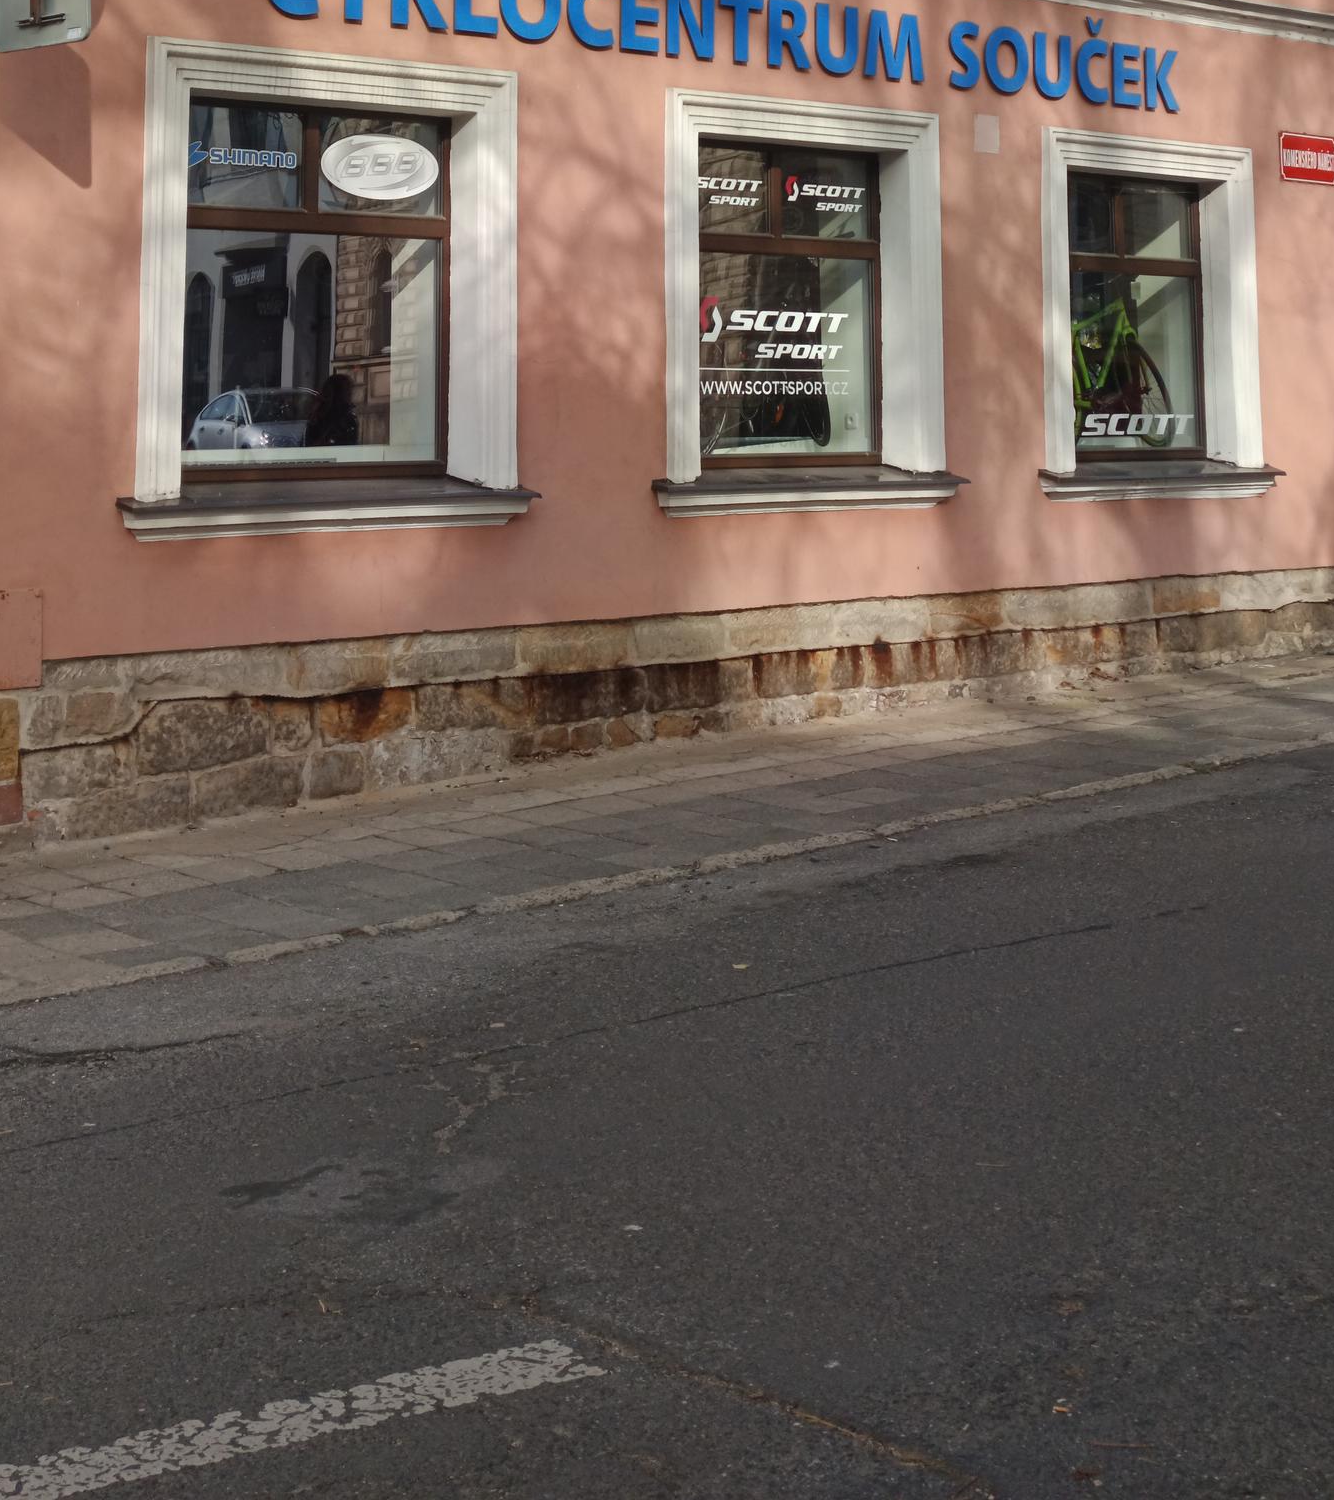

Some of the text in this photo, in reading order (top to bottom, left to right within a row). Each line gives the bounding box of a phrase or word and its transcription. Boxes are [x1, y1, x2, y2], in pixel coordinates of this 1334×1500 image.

[949, 15, 1181, 112] SOUČEK
[209, 147, 297, 169] SHIMANO
[341, 151, 419, 178] BBB
[698, 176, 762, 192] SCOTT
[800, 184, 865, 199] SCOTT
[708, 195, 759, 206] SPORT
[815, 202, 862, 213] SPORT
[726, 310, 849, 333] SCOTT
[755, 343, 843, 360] SPORT
[700, 380, 849, 395] WWW.SCOTTSPORT.CZ
[1081, 413, 1195, 436] SCOTT
